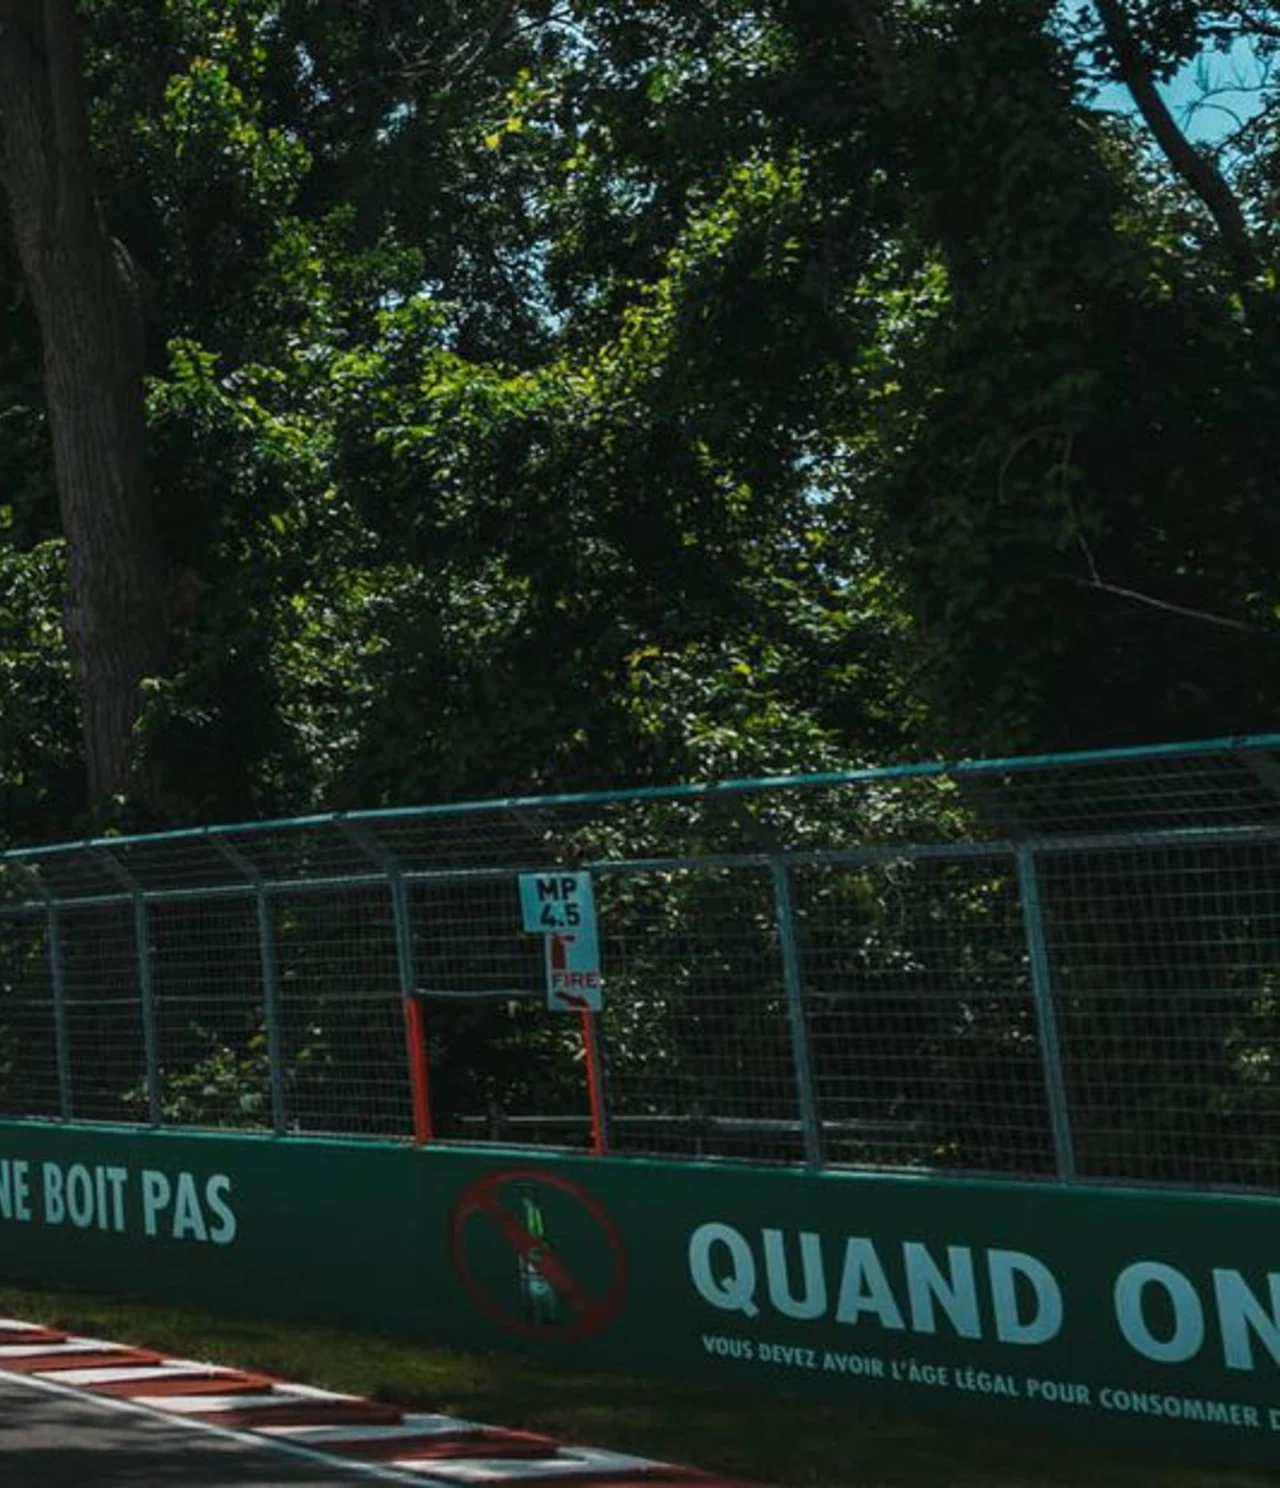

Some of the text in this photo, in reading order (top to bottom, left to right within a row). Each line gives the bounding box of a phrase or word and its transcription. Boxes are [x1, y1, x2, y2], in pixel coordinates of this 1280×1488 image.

[536, 877, 578, 901] MP
[540, 903, 580, 927] 4.5
[550, 972, 598, 989] FIRE
[43, 1162, 127, 1231] BOIT
[143, 1170, 237, 1244] PAS
[687, 1223, 1280, 1370] QUAND ON
[702, 1335, 754, 1360] VOUS
[759, 1342, 816, 1368] DEVEZ
[823, 1352, 883, 1377] AVOIR
[891, 1357, 949, 1387] L'ÂGE
[954, 1364, 1020, 1397] LÉGAL
[1027, 1377, 1091, 1406] POUR
[1099, 1387, 1259, 1427] CONSOMMER
